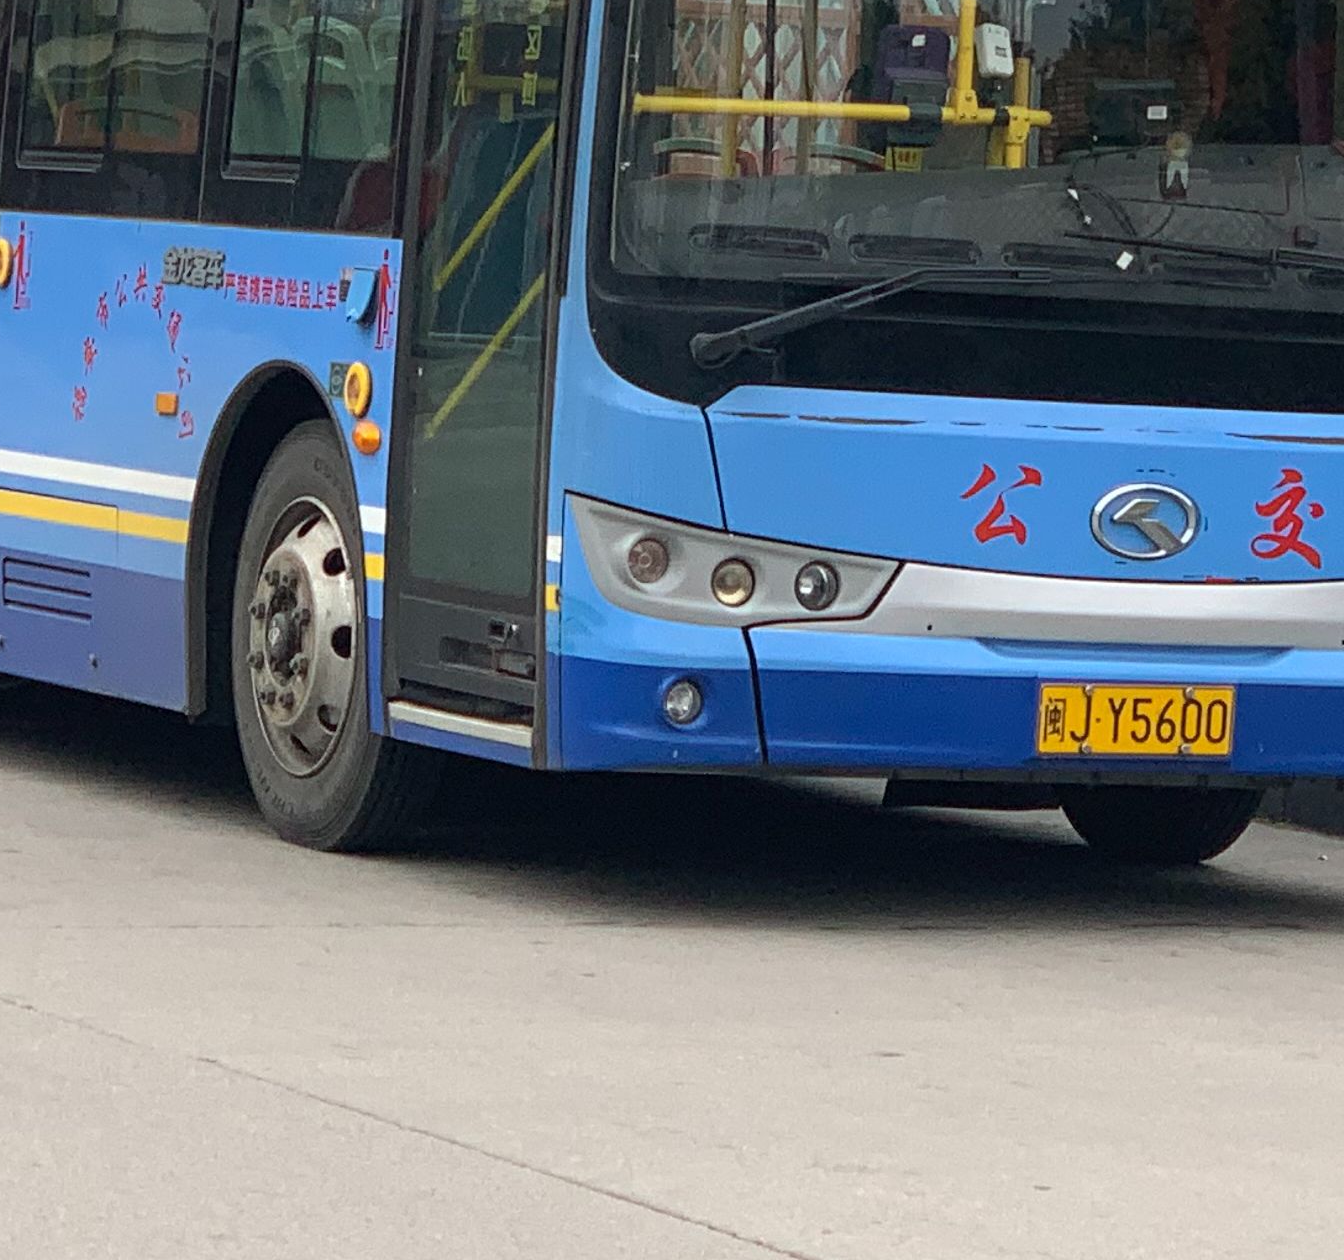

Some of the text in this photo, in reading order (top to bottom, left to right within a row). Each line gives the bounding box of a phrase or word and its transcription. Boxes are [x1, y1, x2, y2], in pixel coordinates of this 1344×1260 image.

[162, 246, 226, 289] 金龙客车
[224, 272, 338, 311] 严禁携带危险品上车
[959, 462, 1325, 570] 公 交
